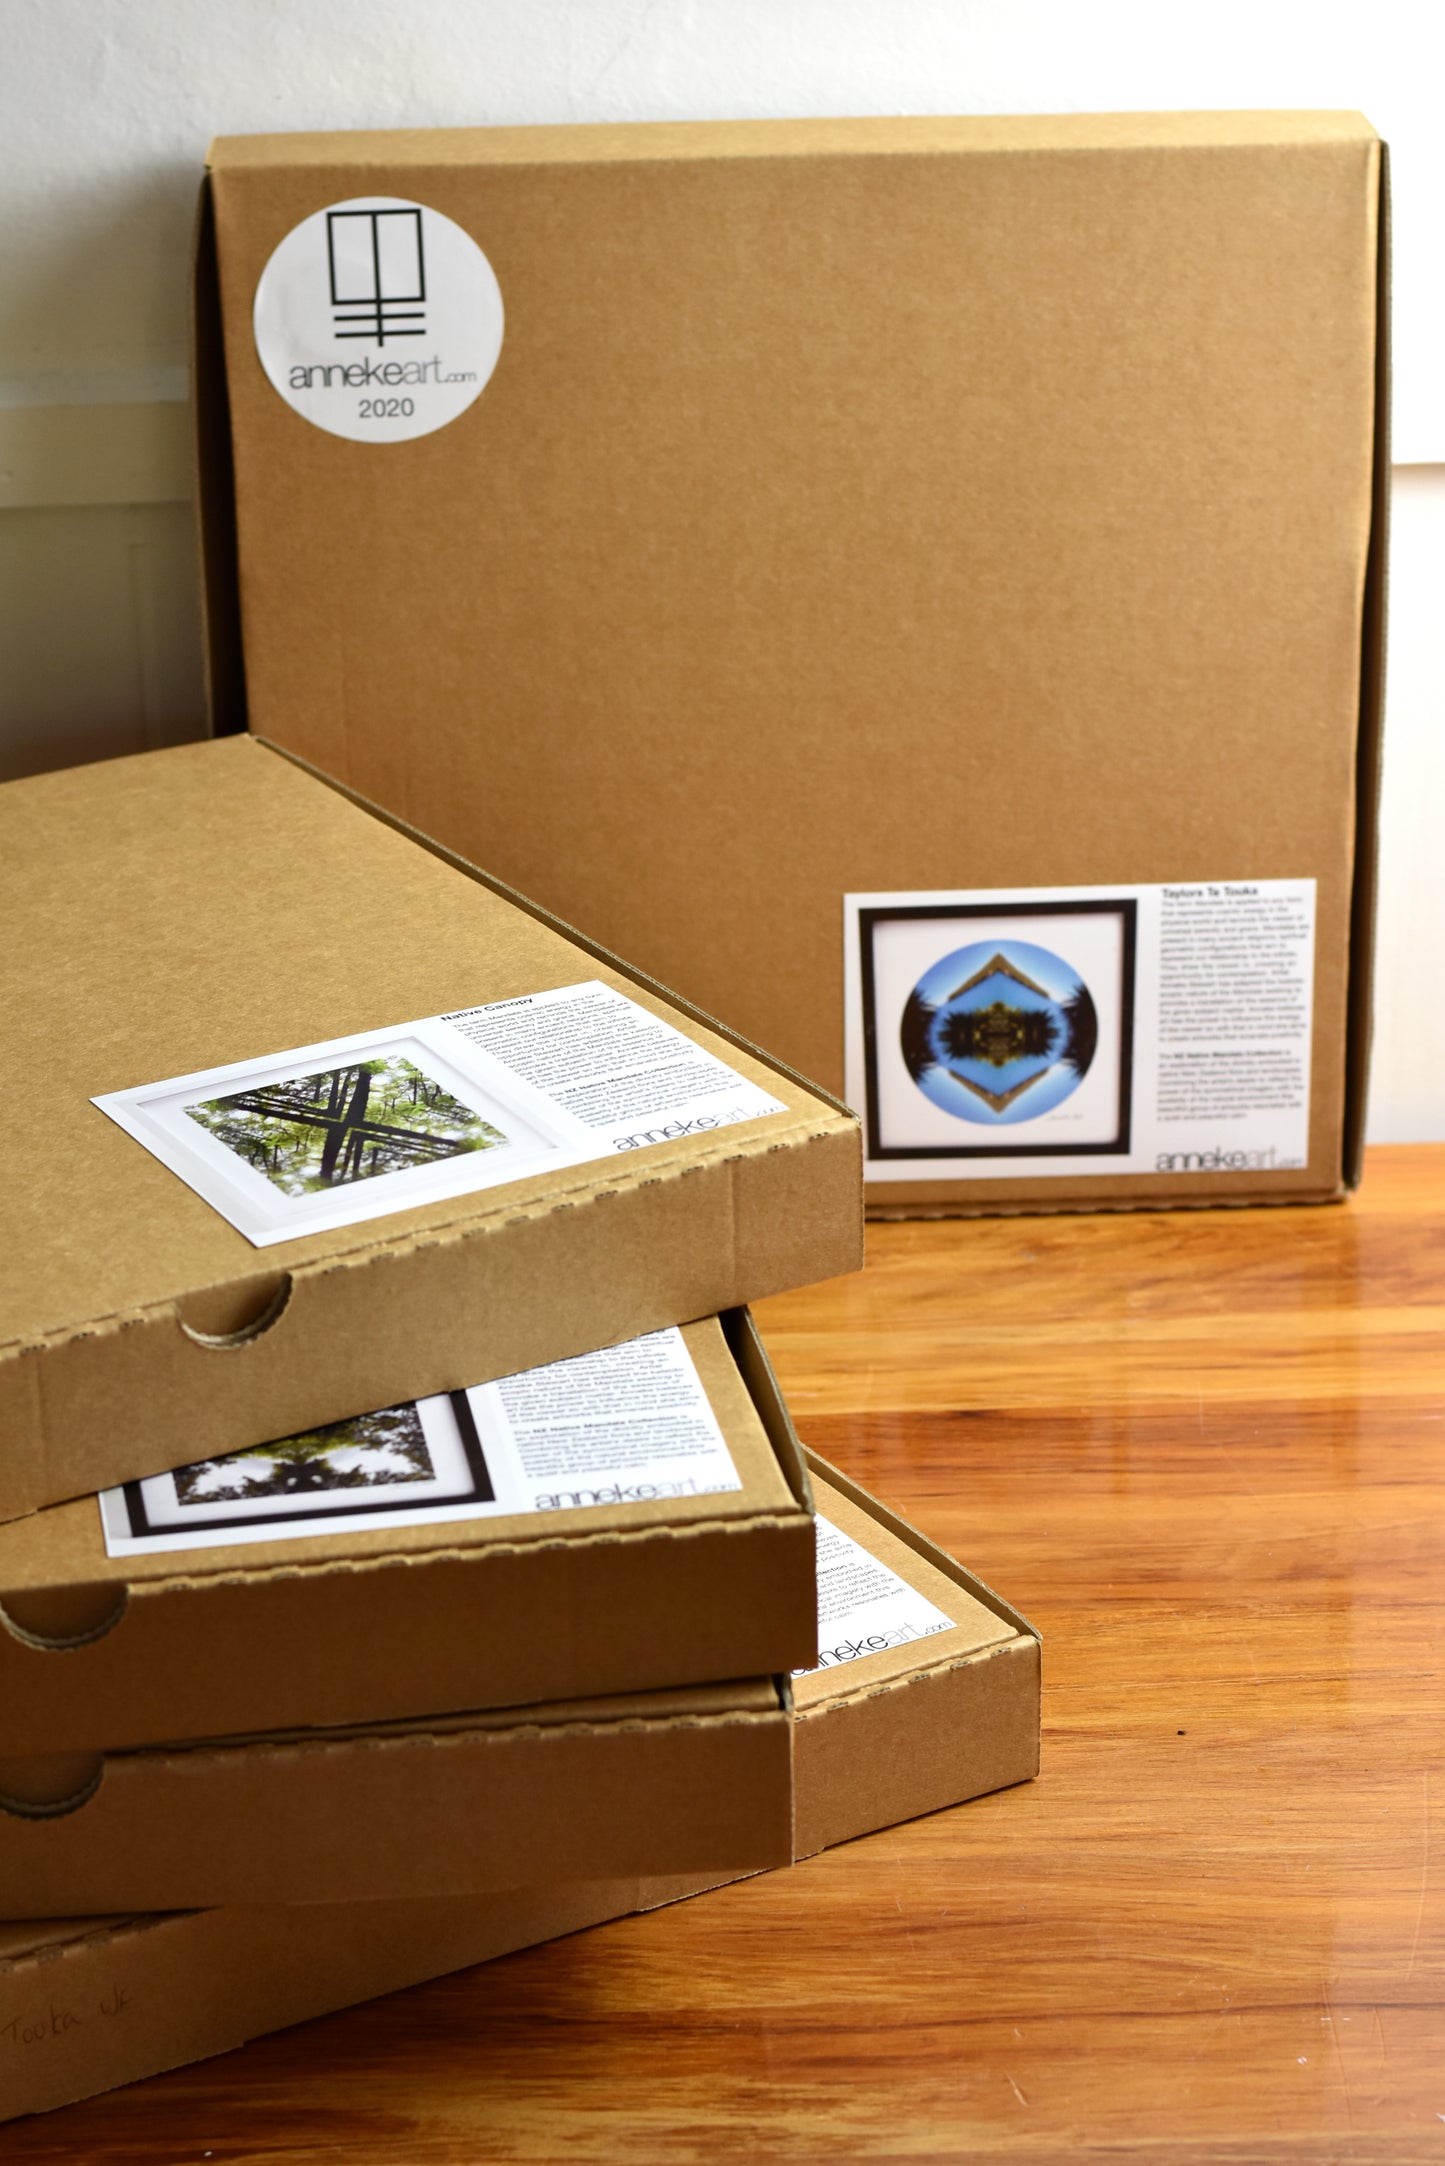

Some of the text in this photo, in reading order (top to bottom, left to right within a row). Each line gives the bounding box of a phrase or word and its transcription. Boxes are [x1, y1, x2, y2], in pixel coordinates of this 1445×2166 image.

[290, 355, 478, 389] annekeart.com
[358, 398, 415, 418] 2020
[440, 998, 533, 1021] Native Canopy
